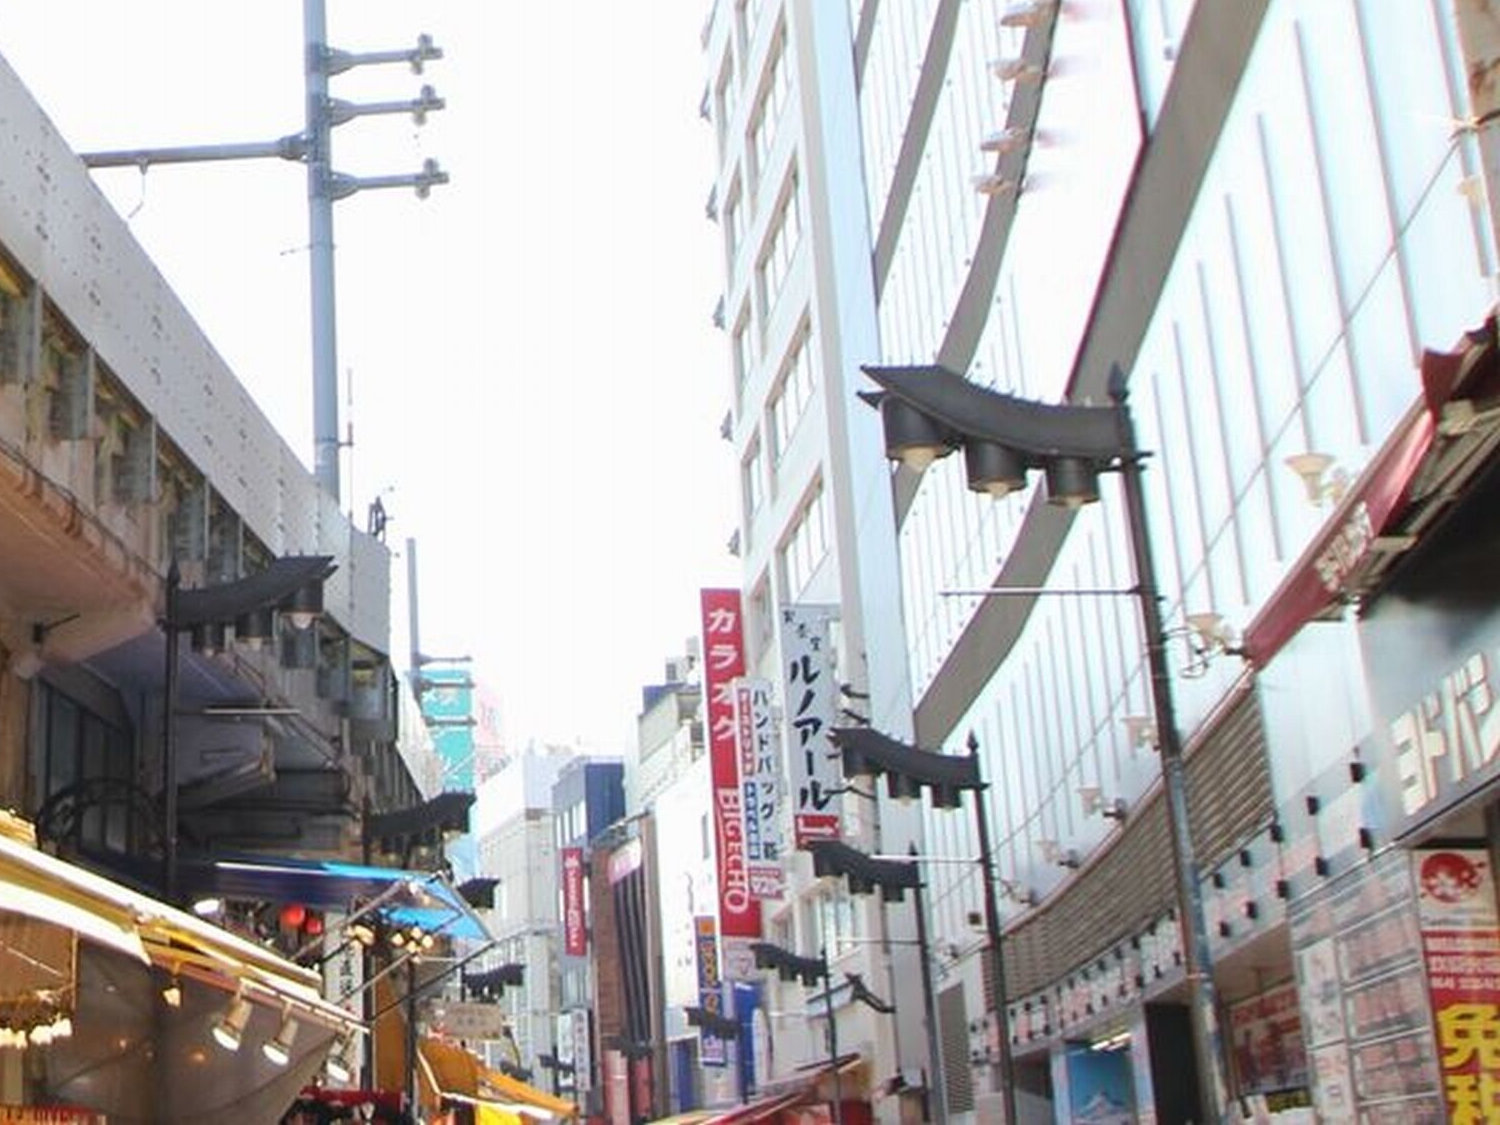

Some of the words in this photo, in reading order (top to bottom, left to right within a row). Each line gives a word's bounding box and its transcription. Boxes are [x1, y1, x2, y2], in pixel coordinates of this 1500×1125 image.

[790, 654, 830, 811] ルノアール
